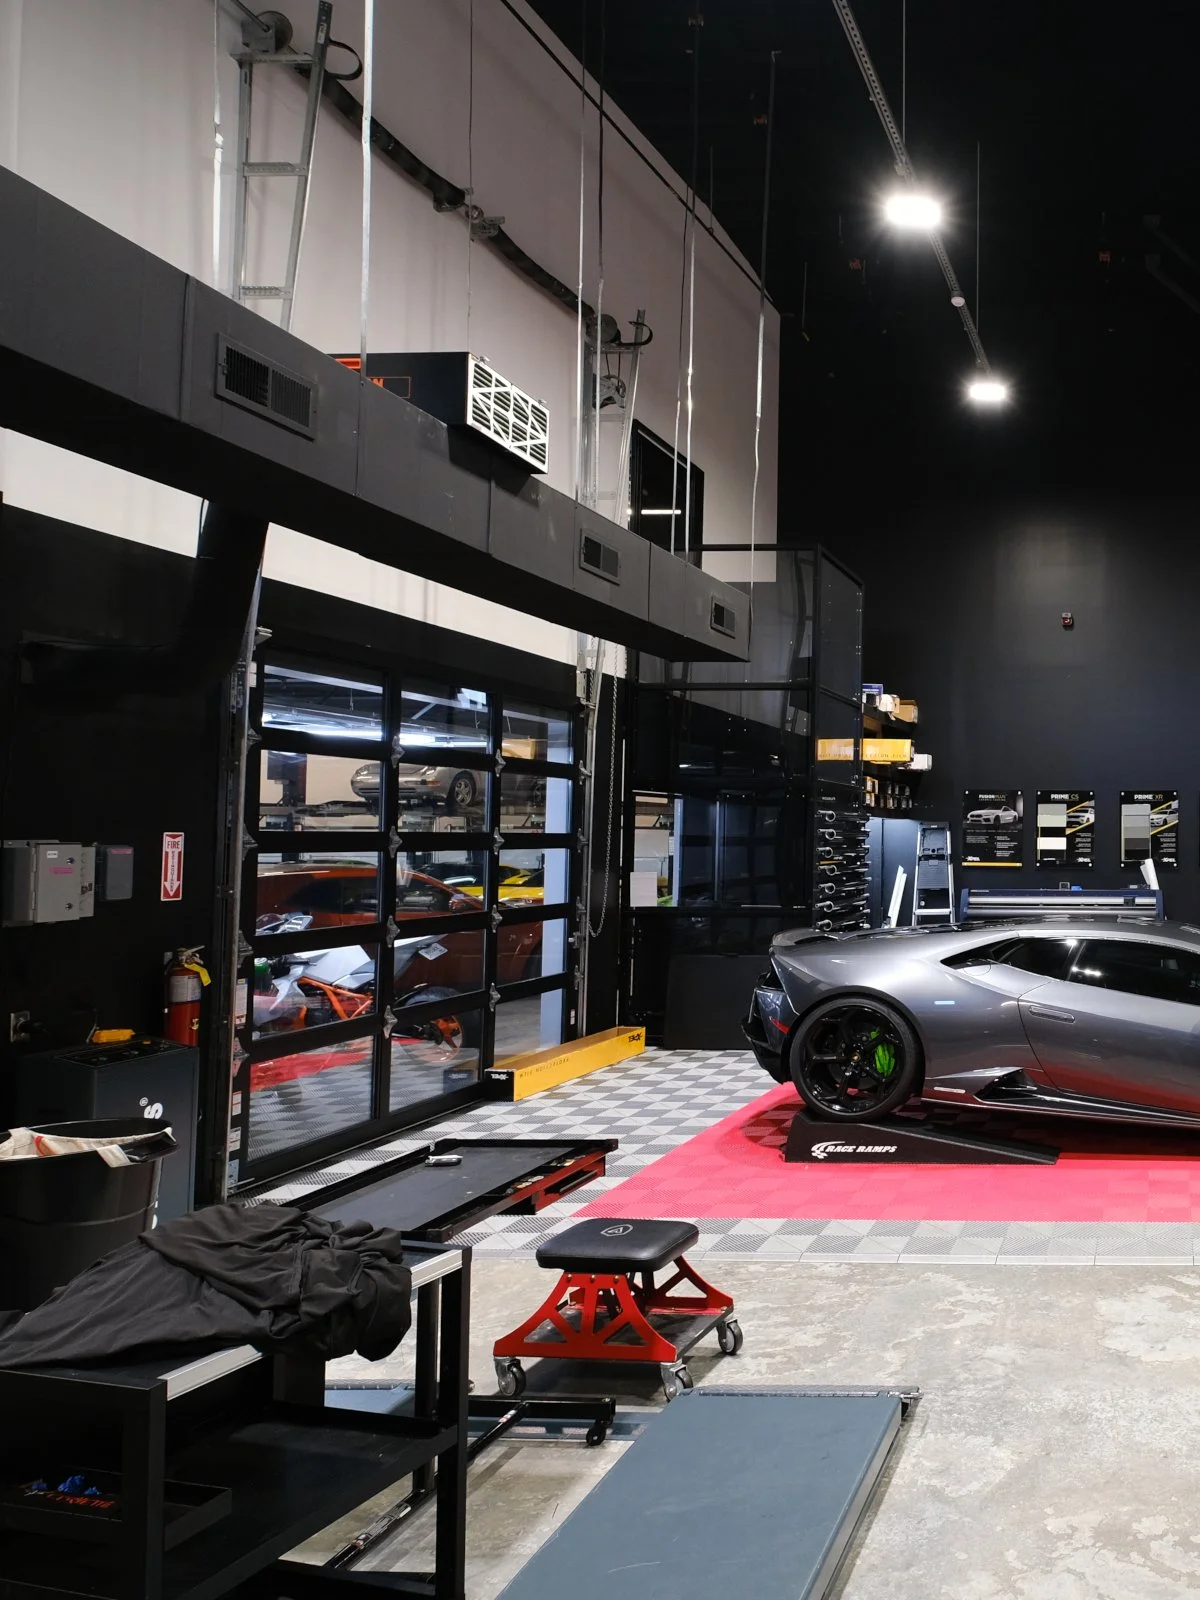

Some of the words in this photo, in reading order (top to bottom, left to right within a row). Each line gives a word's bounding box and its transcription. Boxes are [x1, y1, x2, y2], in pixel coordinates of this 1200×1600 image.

[167, 840, 180, 849] FIRE
[825, 1145, 856, 1153] RACE
[856, 1145, 898, 1153] RAMPS
